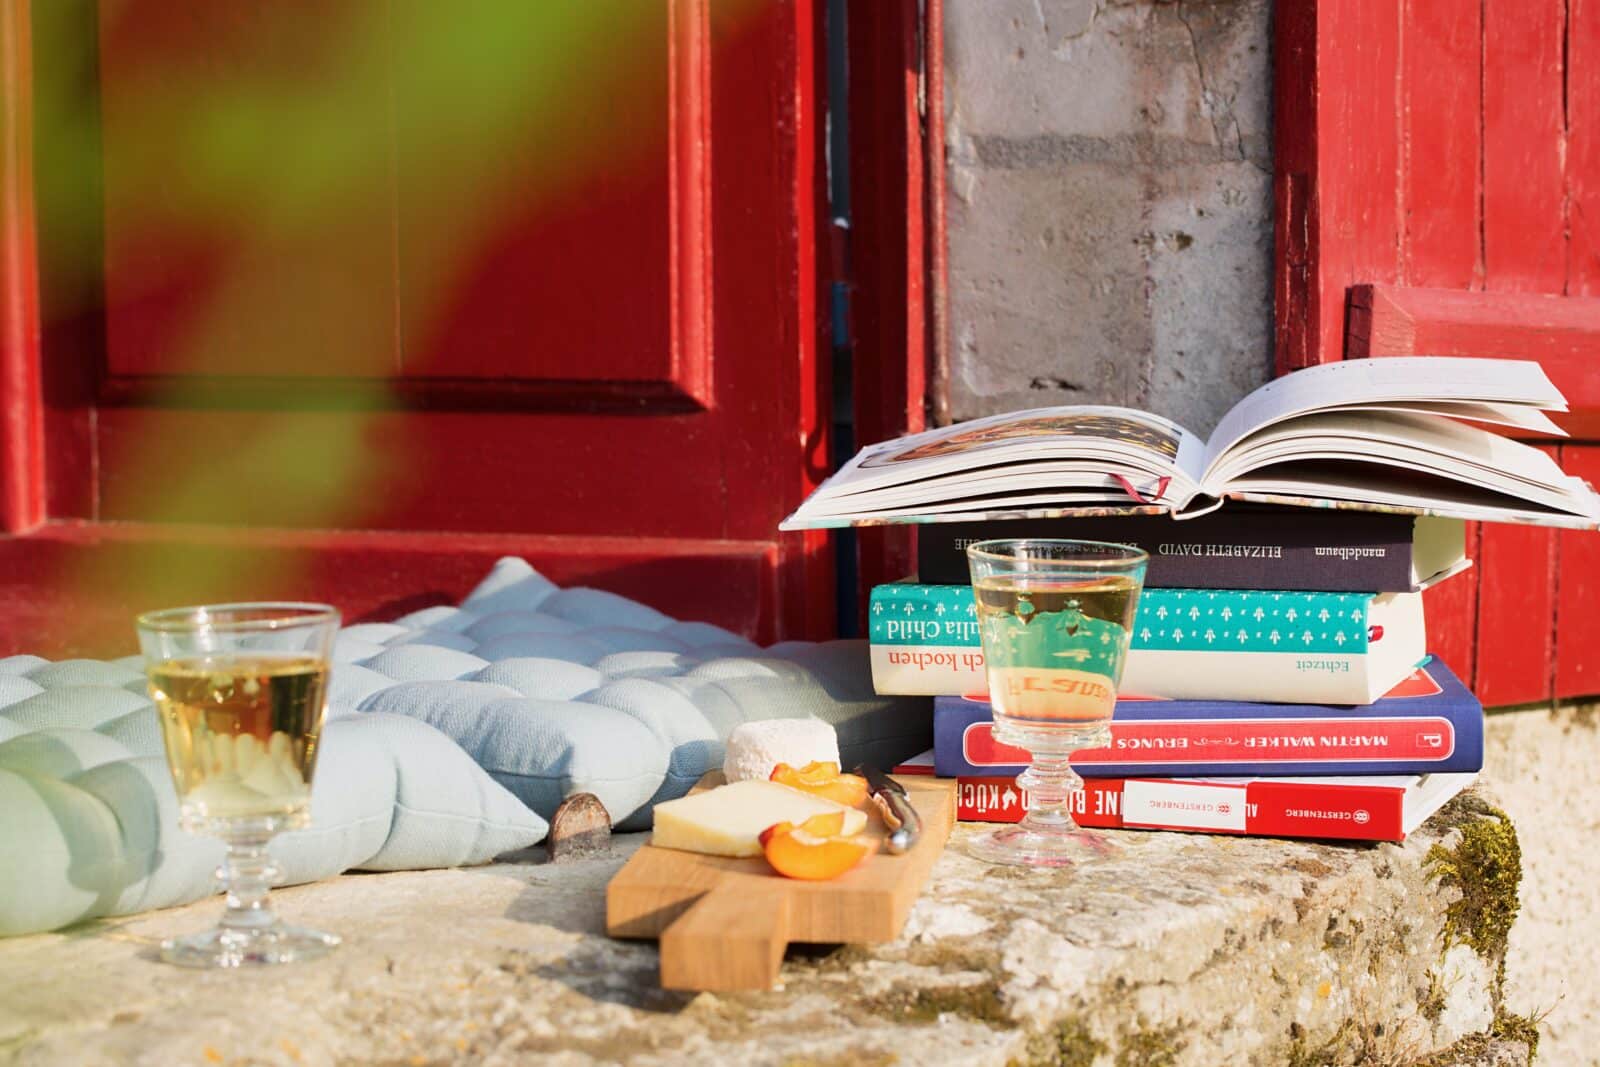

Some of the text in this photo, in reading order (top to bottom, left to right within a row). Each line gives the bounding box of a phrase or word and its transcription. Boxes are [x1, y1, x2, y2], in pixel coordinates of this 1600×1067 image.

[1159, 543, 1203, 556] DAVID
[1206, 544, 1282, 558] ELIZABETH
[1315, 547, 1385, 560] mandelbaum
[886, 620, 981, 641] ulia Child
[888, 652, 958, 671] kochen
[1296, 660, 1349, 672] Echtzeit
[1117, 737, 1188, 749] BRUNOS
[1244, 736, 1316, 748] WALKER
[1320, 735, 1389, 747] MARTIN
[1149, 799, 1214, 813] GERSTENBERG
[1285, 808, 1351, 820] GERSTENBERG
